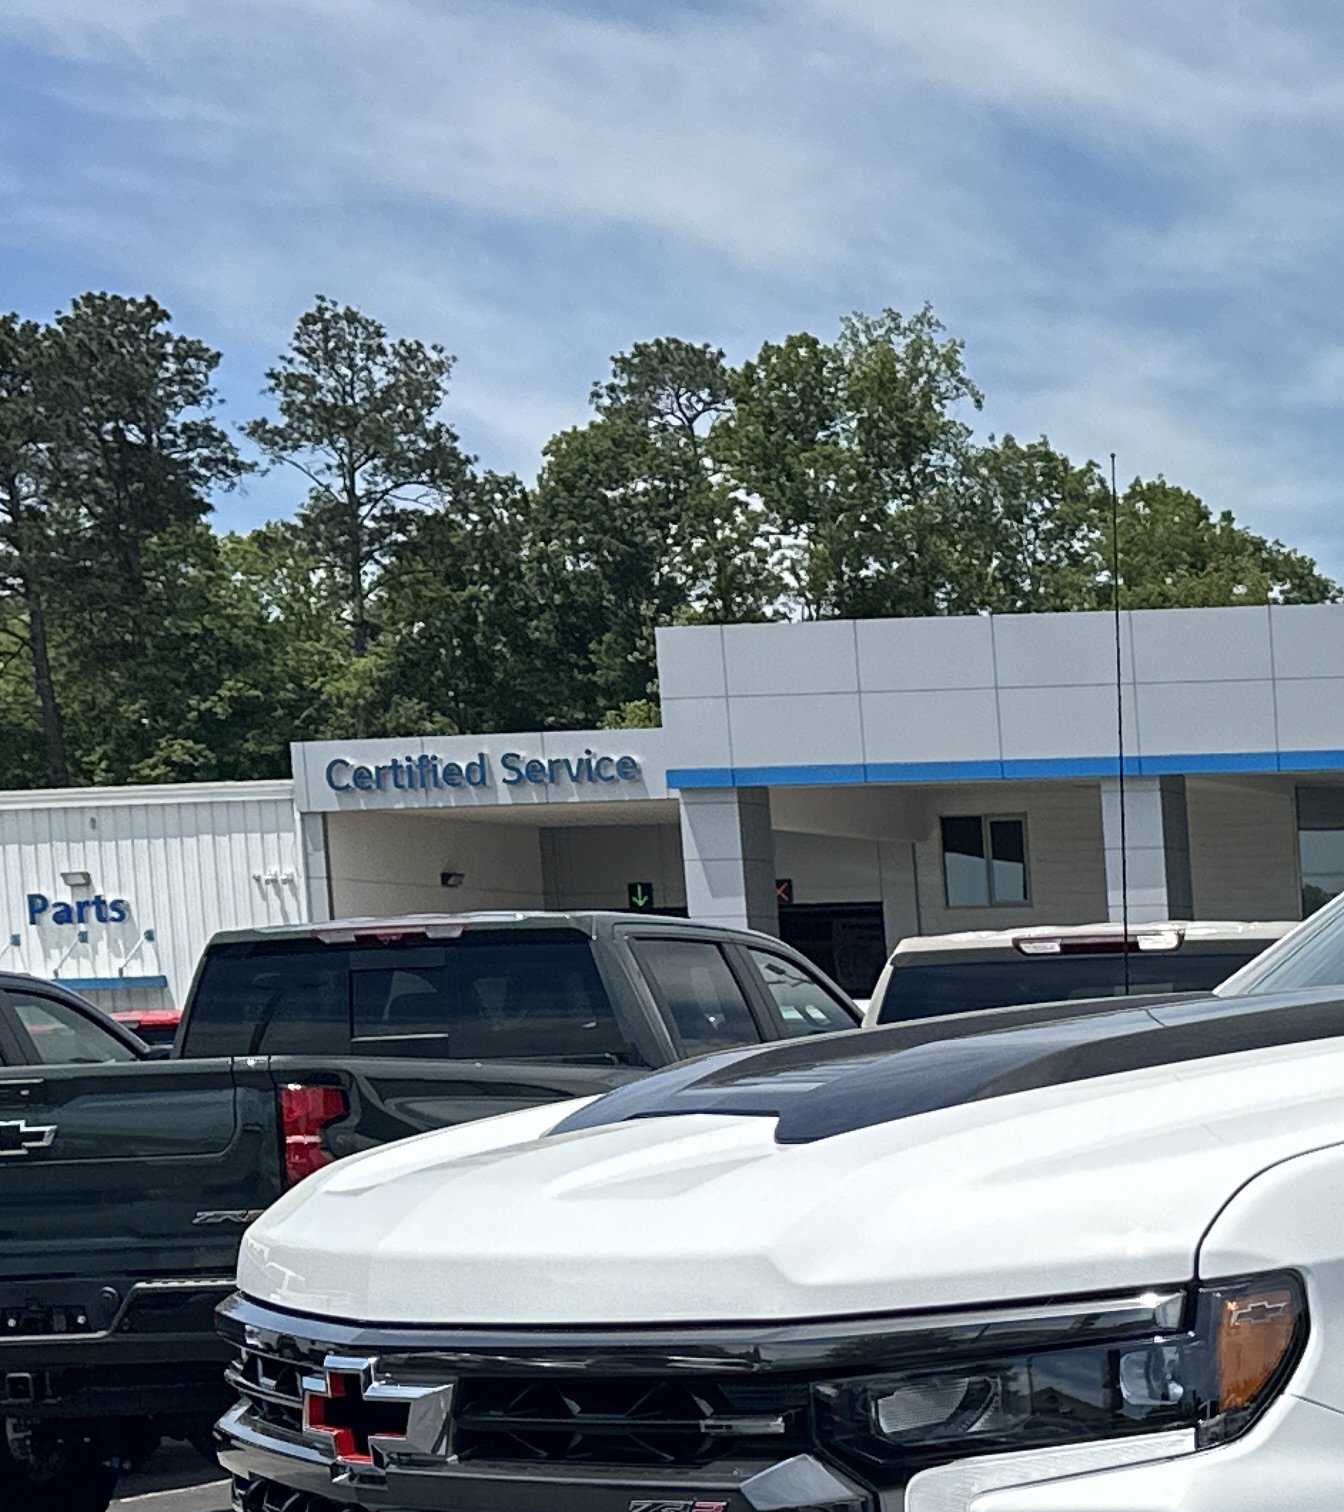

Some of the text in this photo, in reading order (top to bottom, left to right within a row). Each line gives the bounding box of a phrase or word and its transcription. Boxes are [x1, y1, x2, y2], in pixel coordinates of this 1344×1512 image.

[325, 749, 639, 793] Certified Service
[26, 893, 128, 926] Parts
